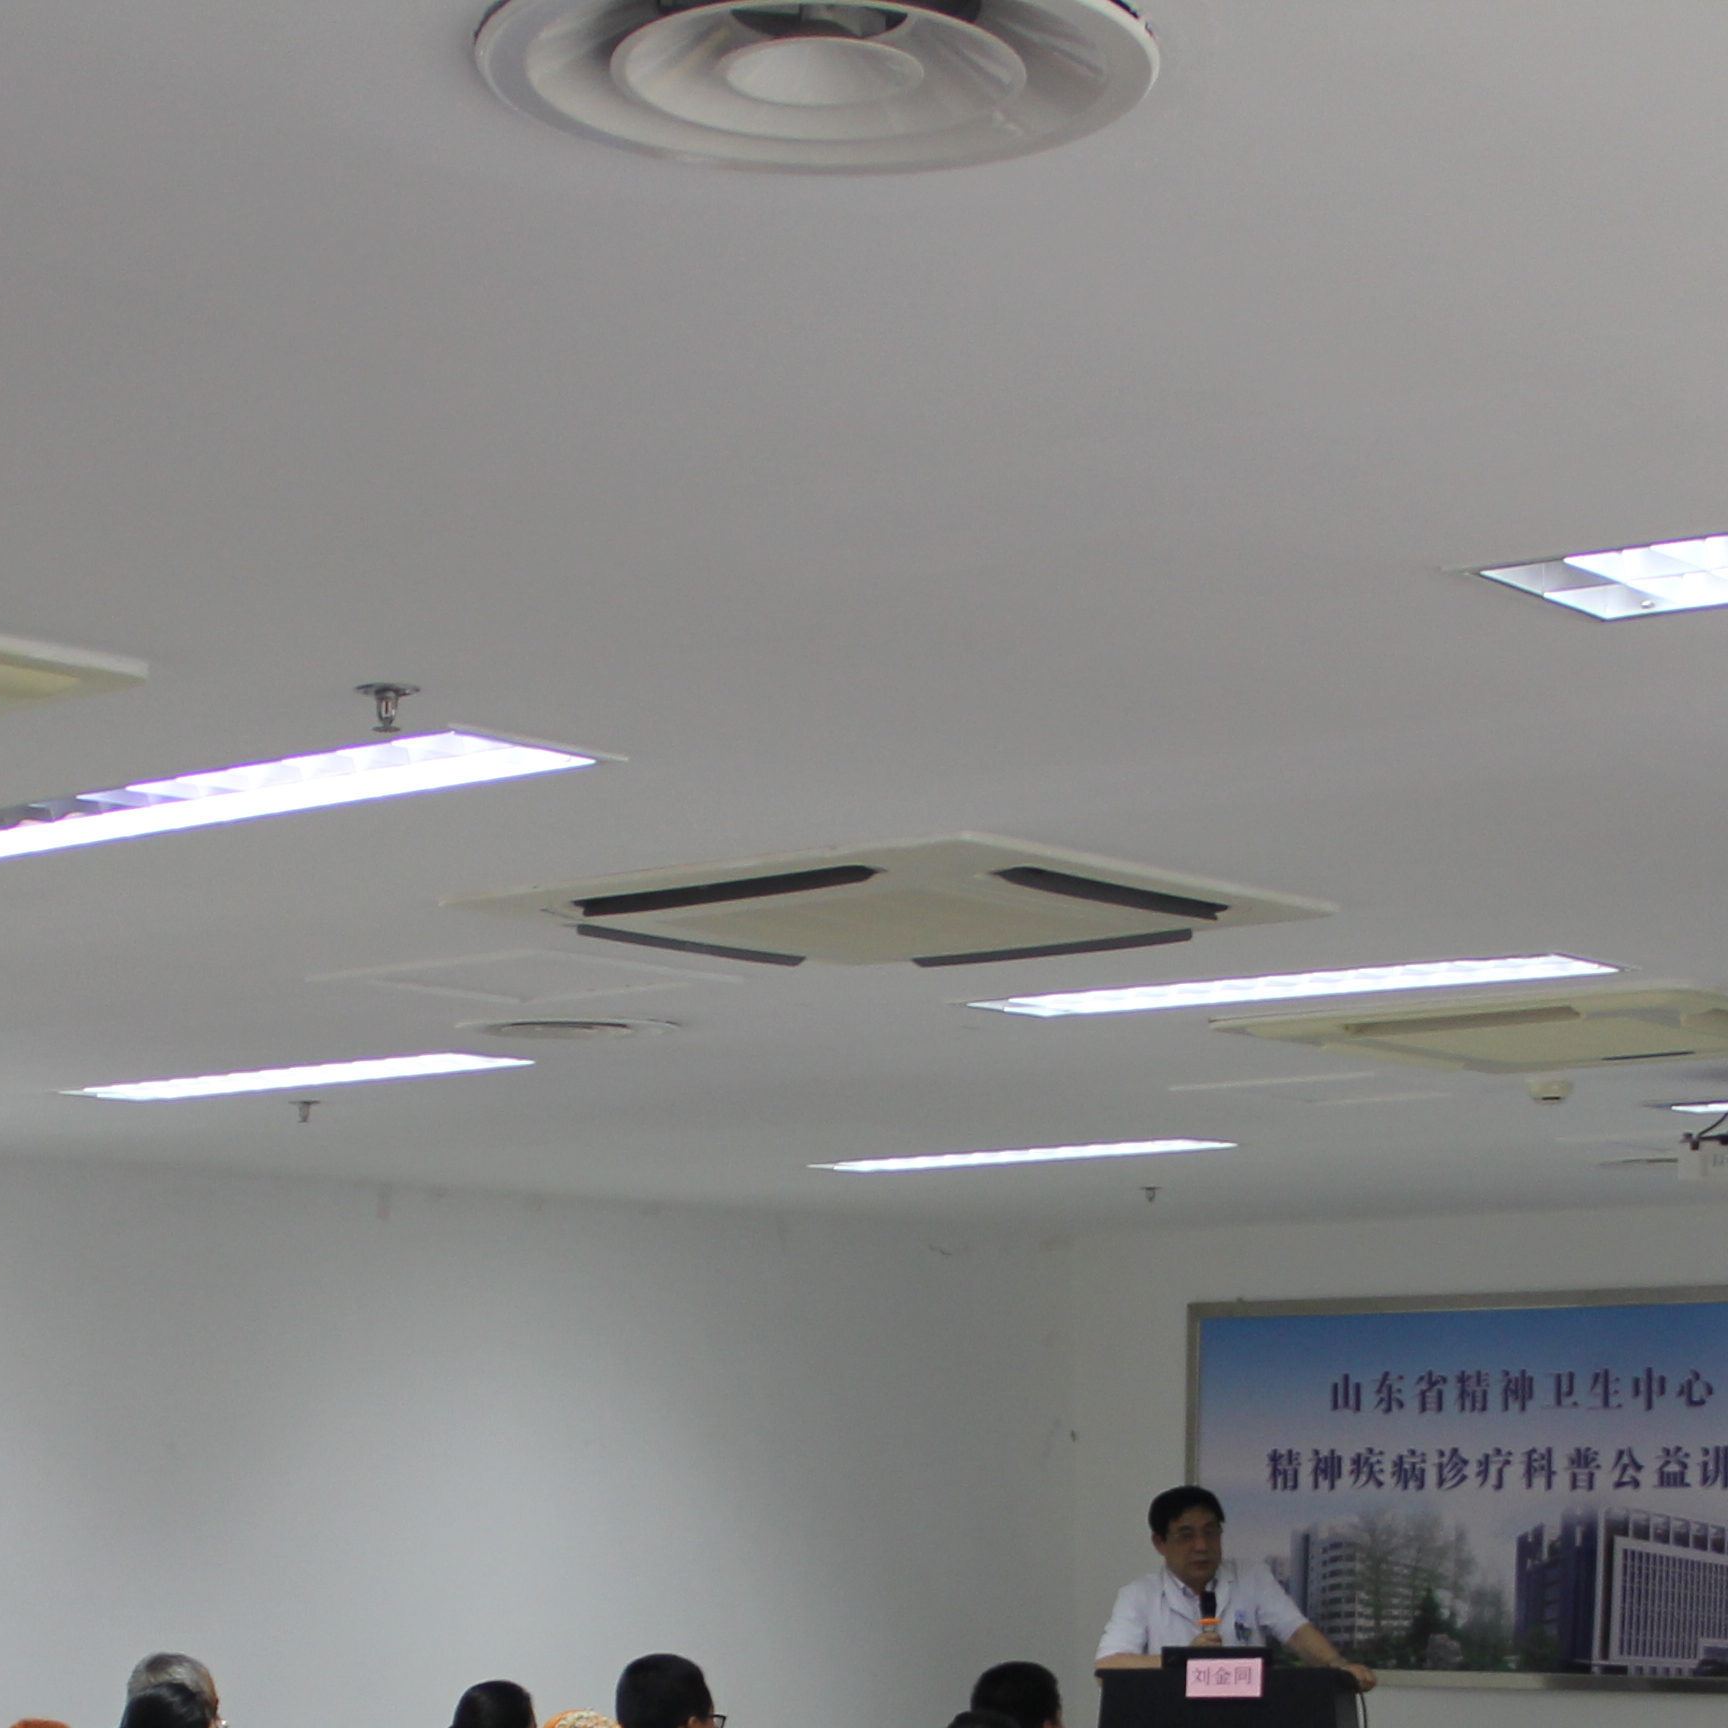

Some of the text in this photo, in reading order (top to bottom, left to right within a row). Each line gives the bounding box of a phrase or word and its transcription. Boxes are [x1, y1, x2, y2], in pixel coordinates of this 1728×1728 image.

[1330, 1367, 1714, 1414] 山东省精神卫生中心
[1192, 1667, 1252, 1686] 刘金同
